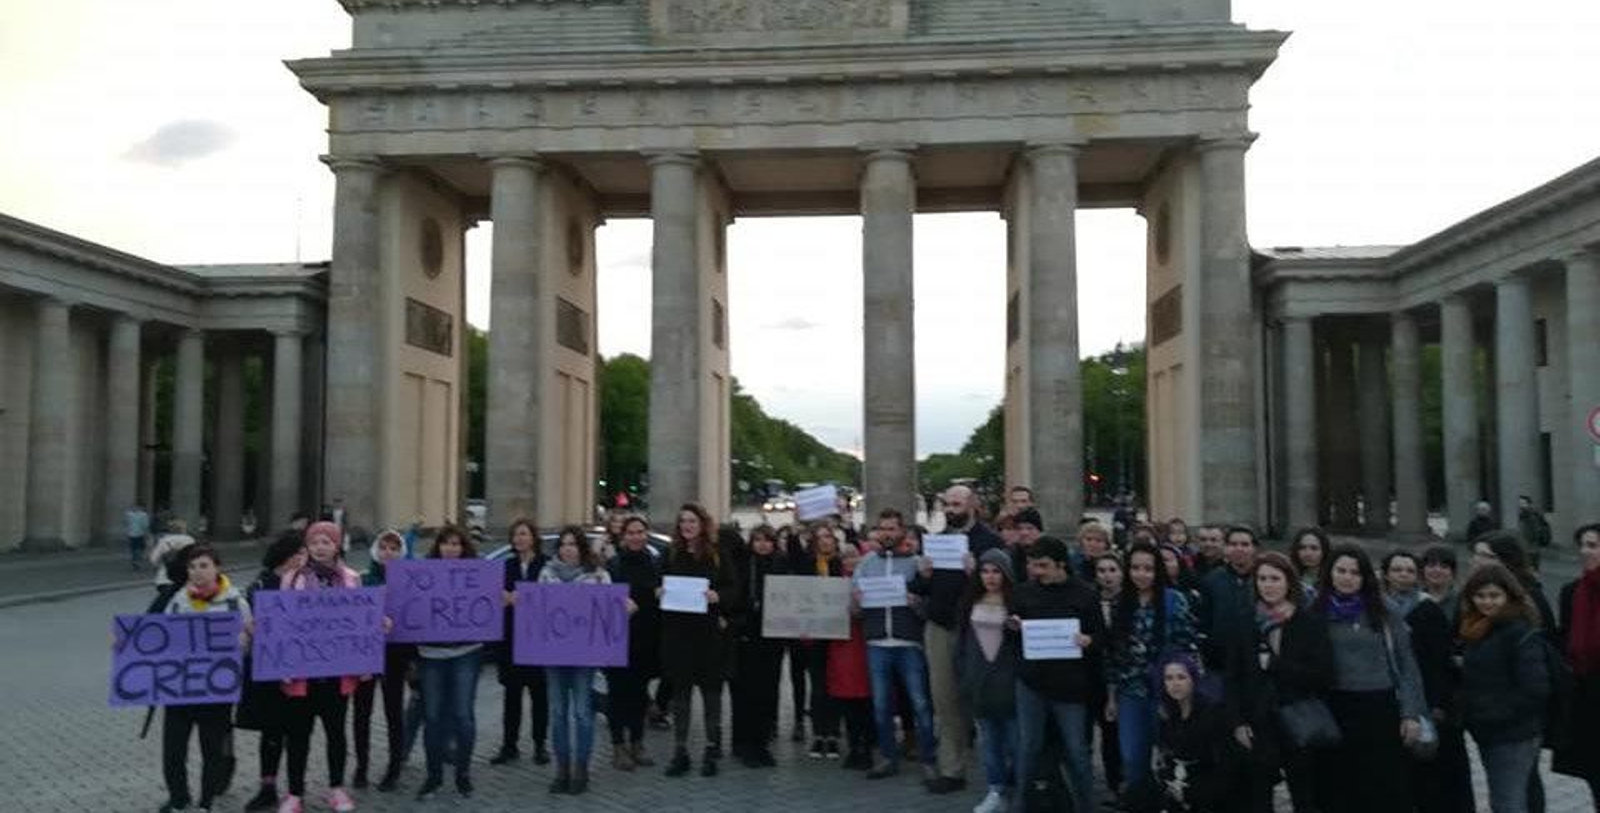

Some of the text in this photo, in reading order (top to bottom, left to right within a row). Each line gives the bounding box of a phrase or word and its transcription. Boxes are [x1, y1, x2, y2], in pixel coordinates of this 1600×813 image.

[404, 567, 480, 592] YO TE
[401, 595, 496, 632] CREO
[114, 616, 236, 655] YO TE
[115, 657, 241, 700] CREO
